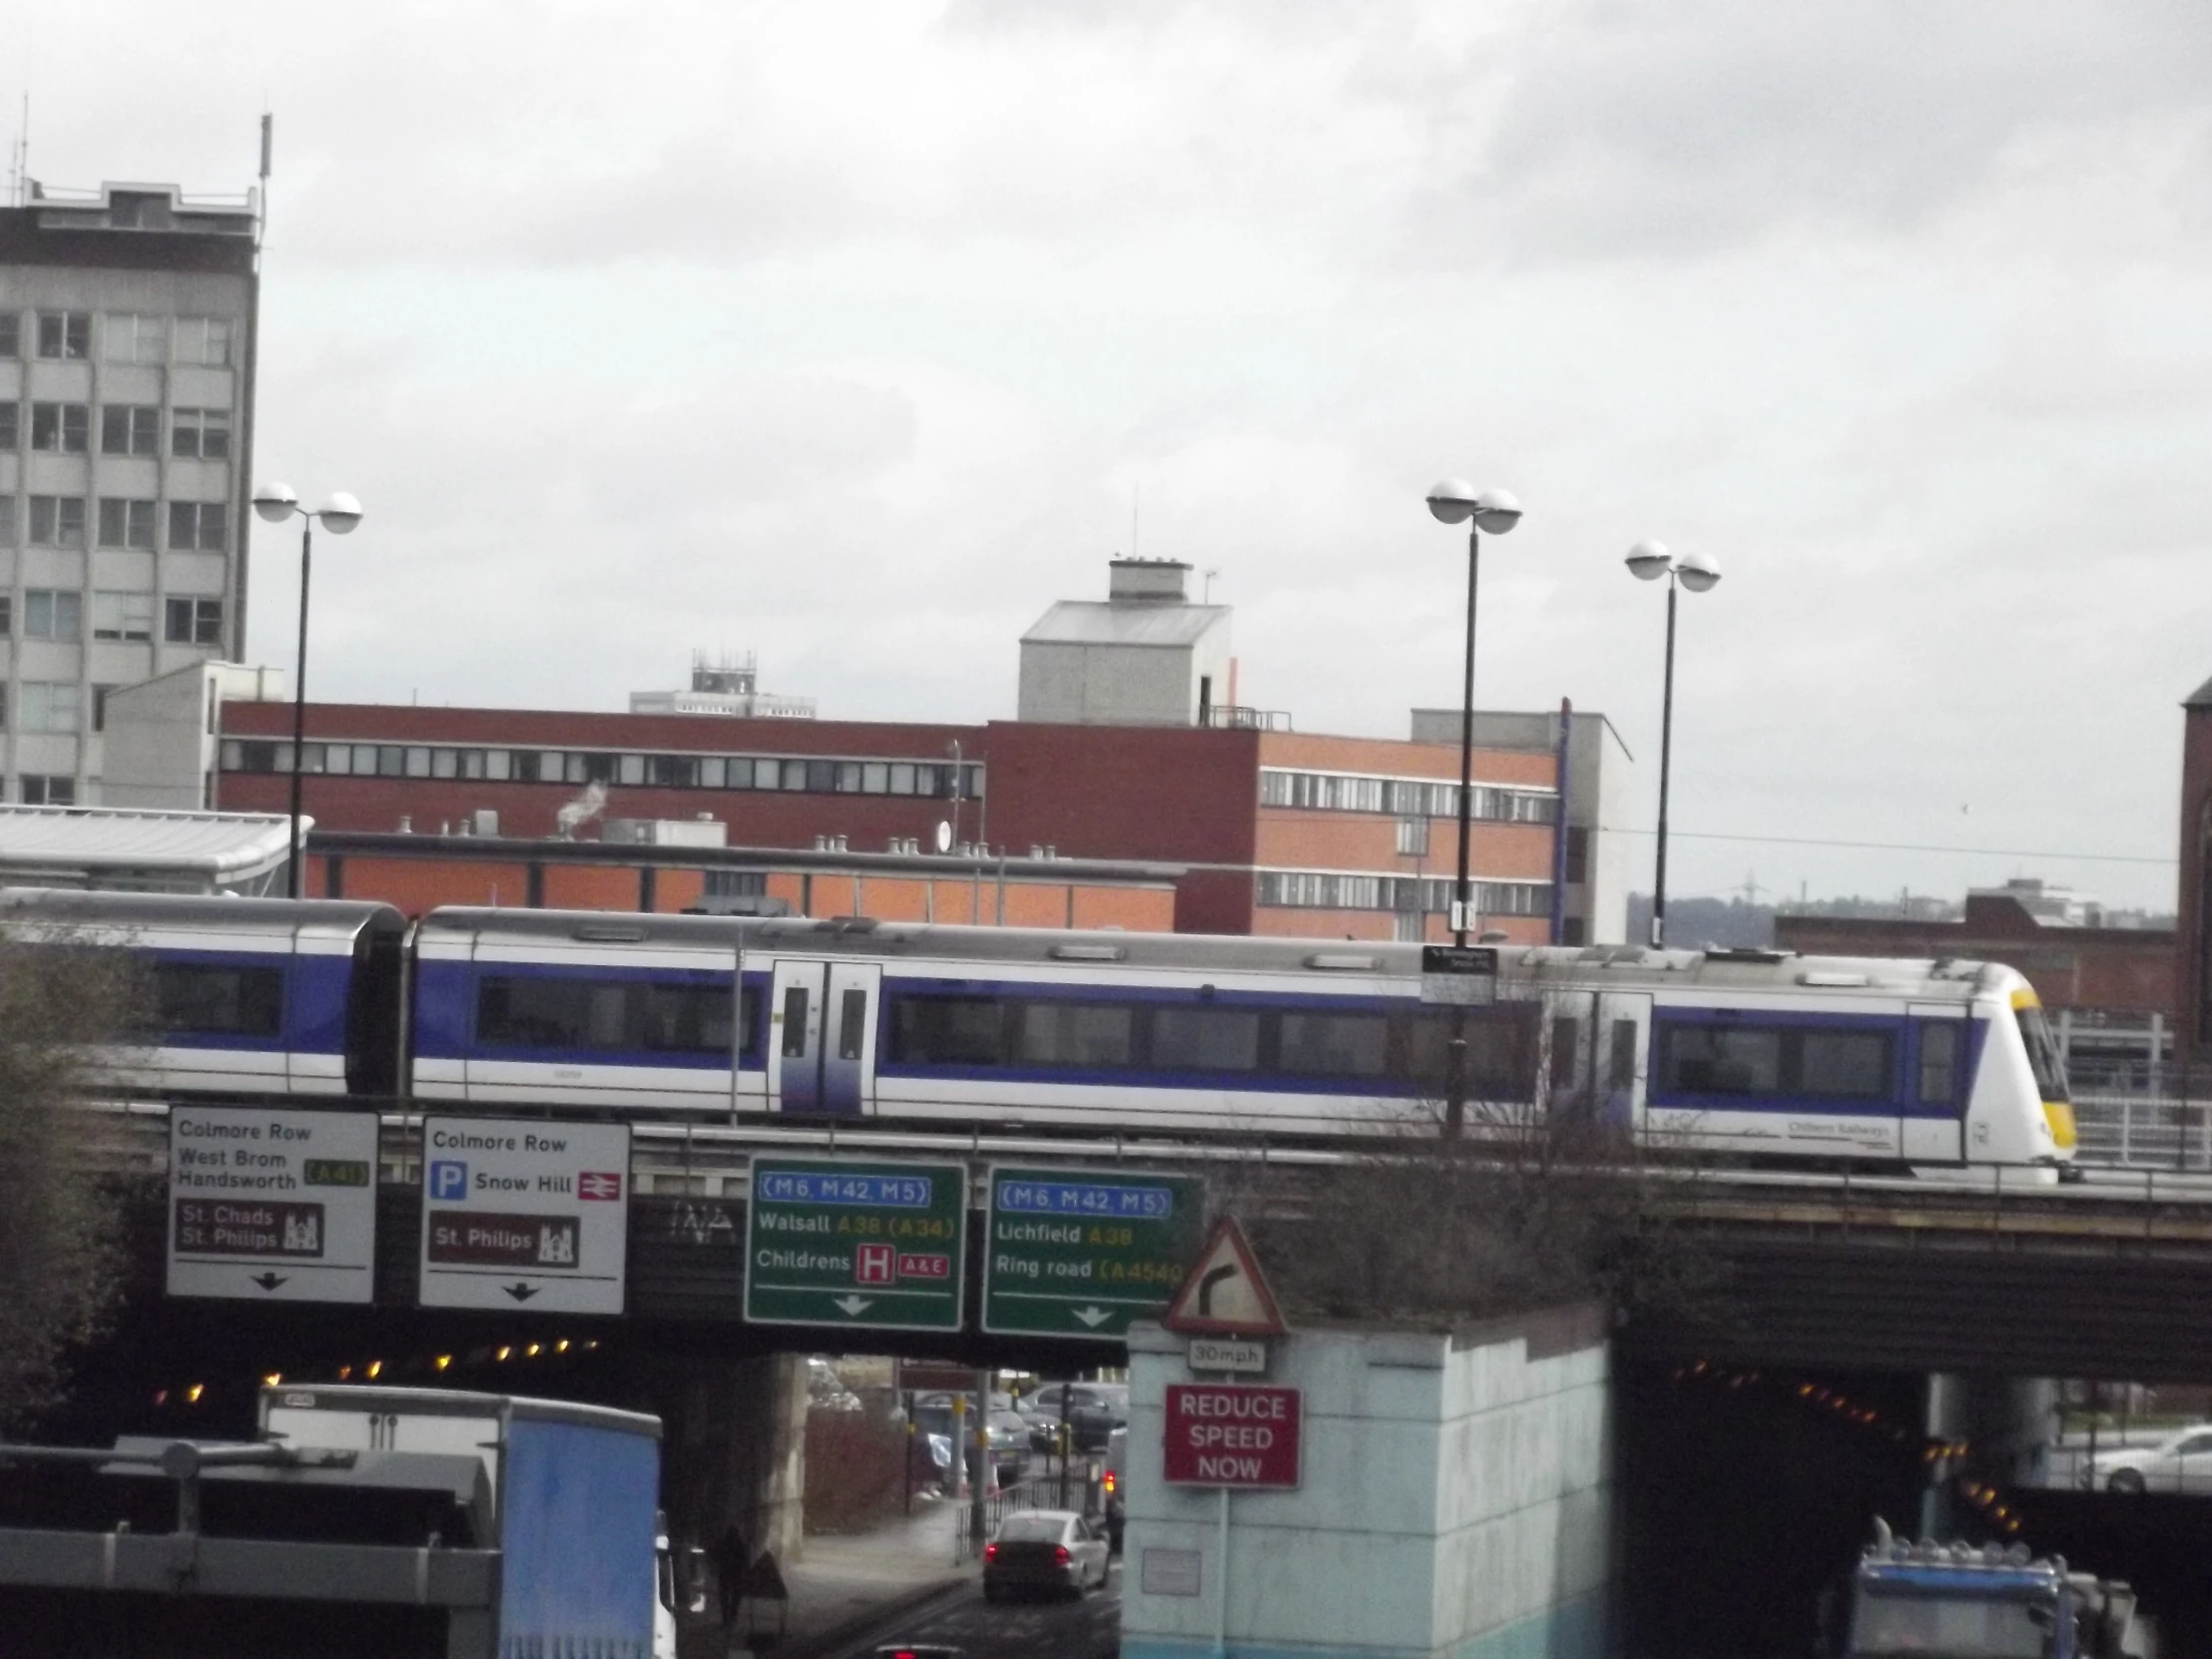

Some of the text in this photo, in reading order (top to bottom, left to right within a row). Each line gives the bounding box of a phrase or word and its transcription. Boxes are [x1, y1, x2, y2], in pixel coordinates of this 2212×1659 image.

[179, 1120, 312, 1141] Colmore Row
[433, 1131, 567, 1152] Colmore Row
[178, 1147, 287, 1168] West Brom
[178, 1169, 296, 1190] Handsworth
[438, 1165, 462, 1197] P
[475, 1173, 572, 1193] Snow Hill
[215, 1206, 275, 1225] Chads
[759, 1212, 830, 1233] Walsall
[836, 1215, 880, 1235] A38
[888, 1219, 954, 1239] (A34)
[214, 1229, 277, 1249] Philips
[468, 1229, 533, 1250] Philips
[998, 1221, 1133, 1245] Lichfield A38
[757, 1248, 888, 1280] Childrens H
[996, 1255, 1040, 1278] Ring
[1048, 1259, 1092, 1278] road
[1180, 1393, 1286, 1419] REDUCE
[1189, 1424, 1273, 1449] SPEED
[1199, 1455, 1262, 1480] NOW
